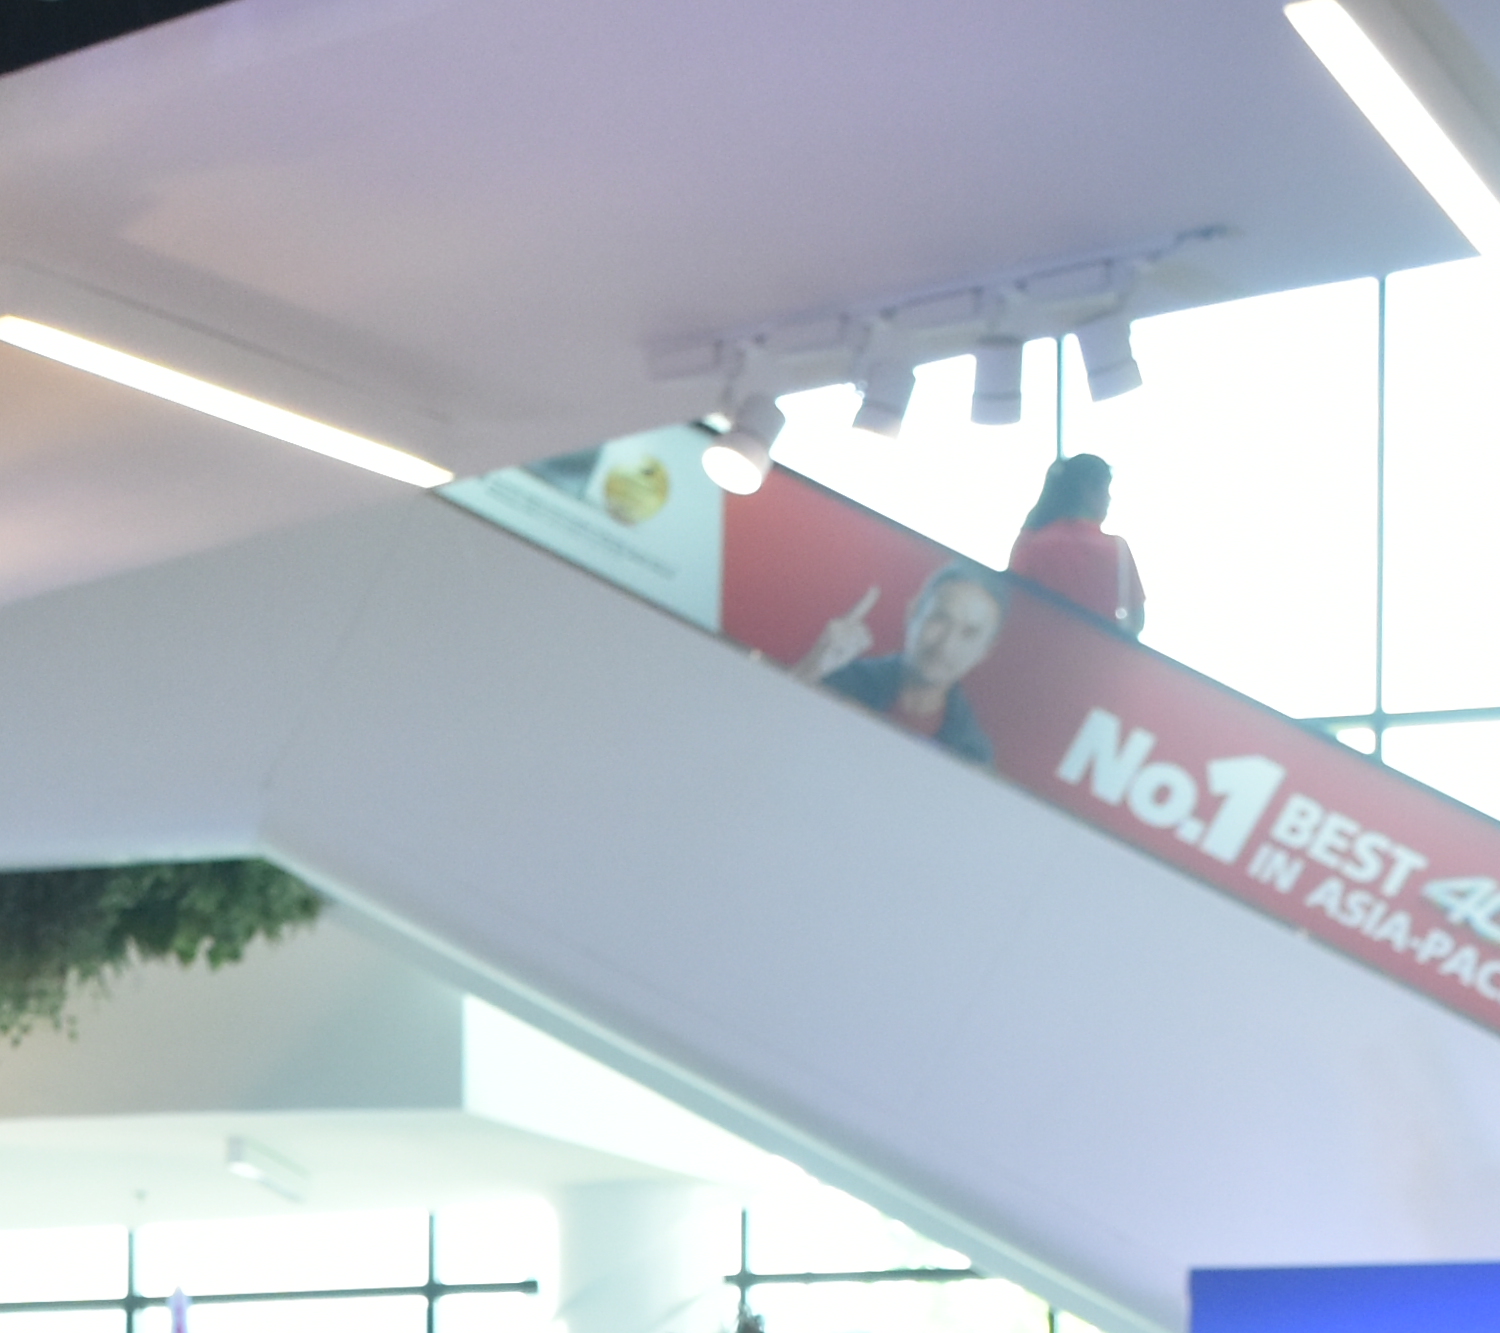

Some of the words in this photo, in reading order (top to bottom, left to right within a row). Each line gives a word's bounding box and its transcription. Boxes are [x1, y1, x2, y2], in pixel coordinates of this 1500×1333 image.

[1056, 707, 1286, 864] No.1
[1247, 843, 1303, 894] IN
[1271, 792, 1428, 898] BEST
